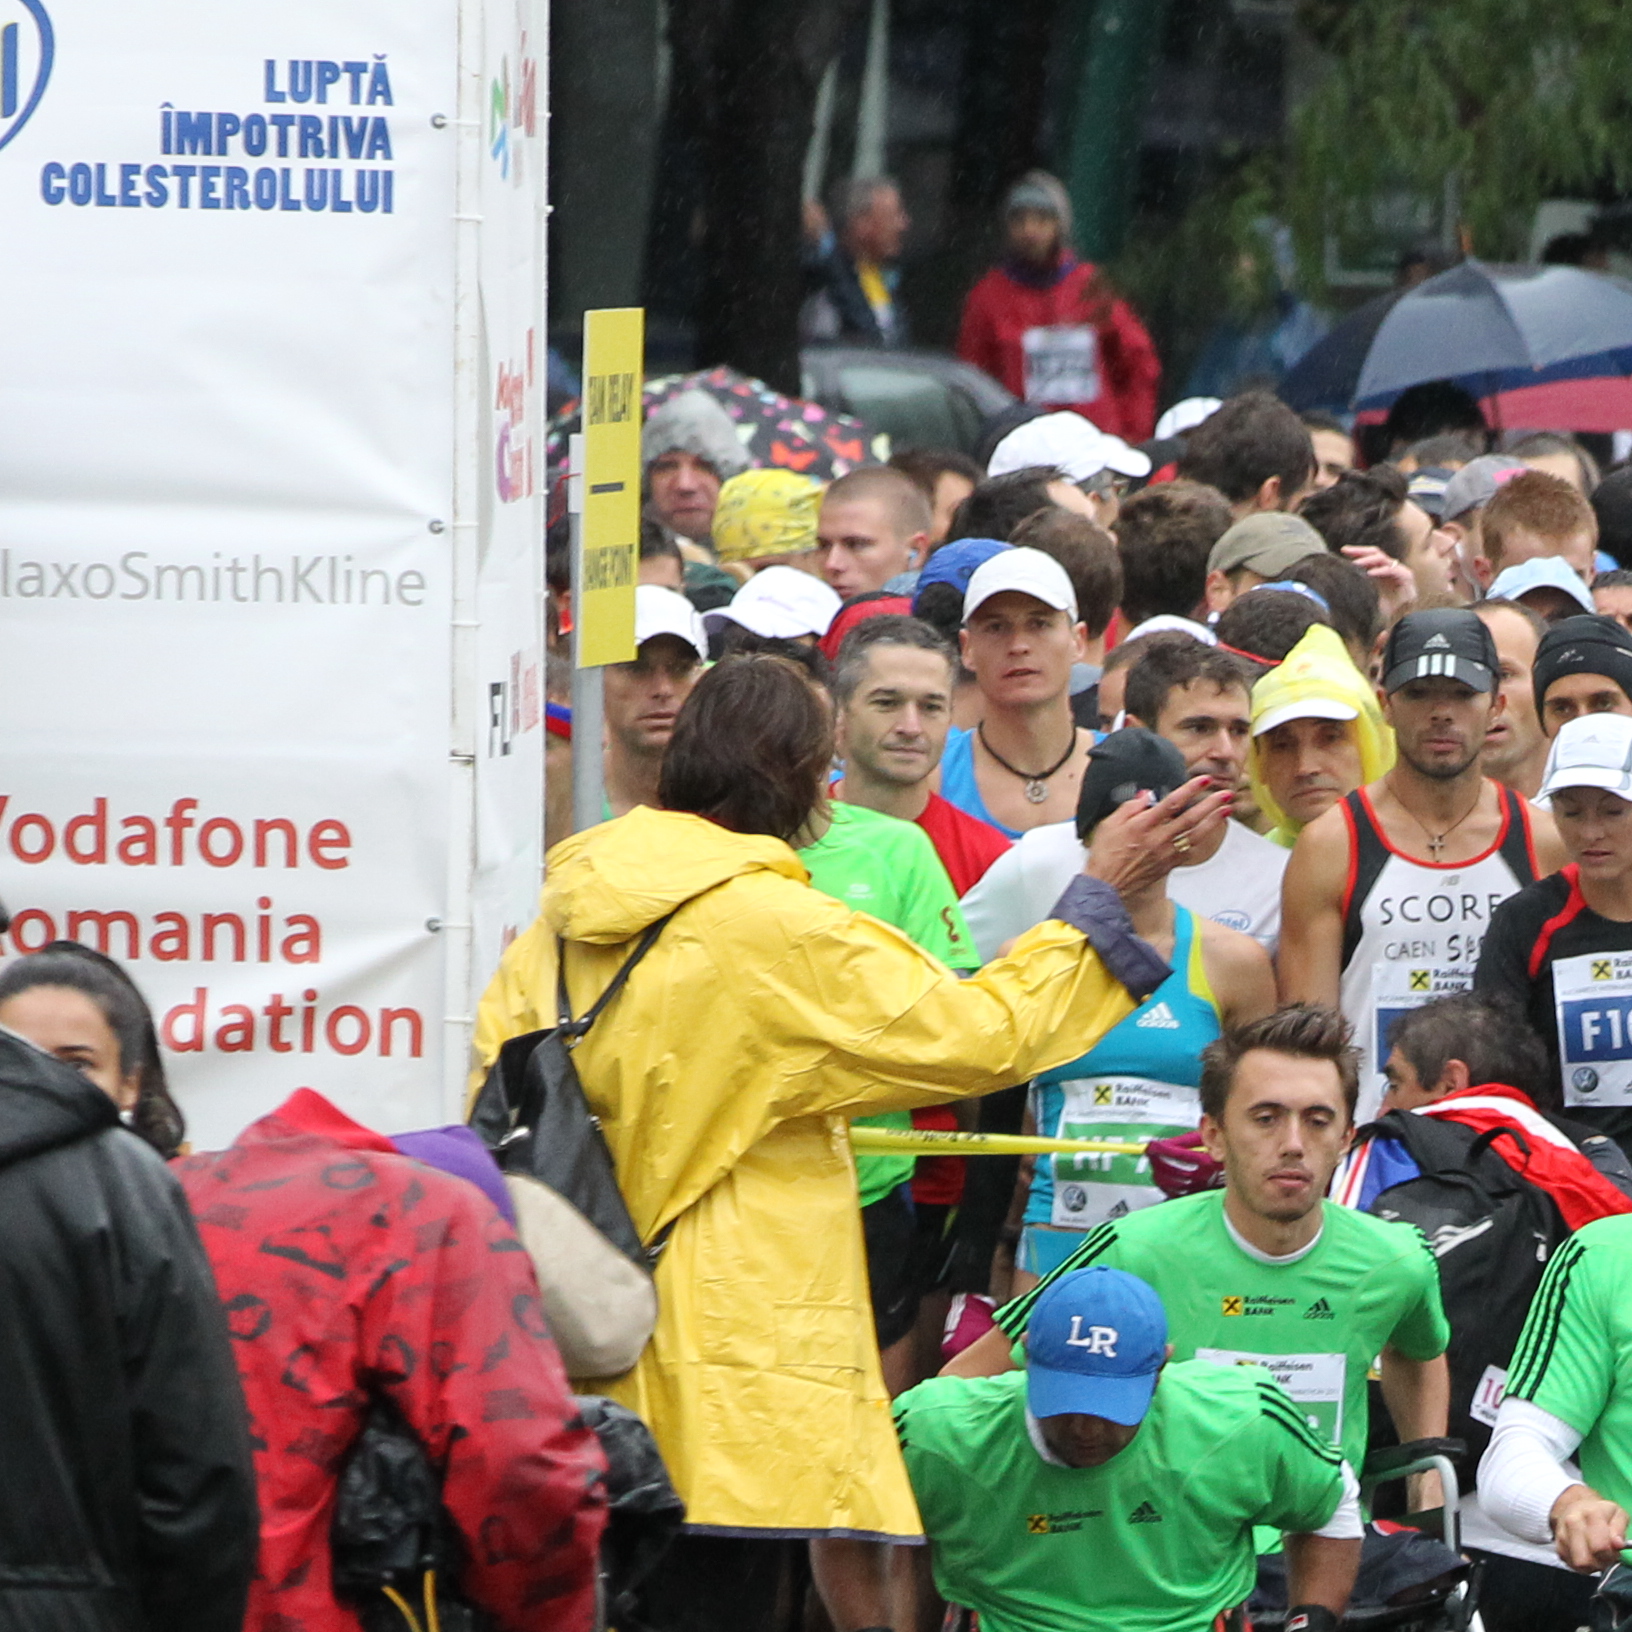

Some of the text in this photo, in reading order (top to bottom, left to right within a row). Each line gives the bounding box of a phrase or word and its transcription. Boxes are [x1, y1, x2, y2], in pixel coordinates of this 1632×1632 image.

[264, 54, 393, 106] LUPTĂ
[159, 102, 394, 160] ÎMPOTRIVA
[41, 162, 394, 214] COLESTEROLULUI
[0, 896, 323, 964] omania
[1385, 941, 1436, 961] CAEN
[161, 986, 424, 1058] dation
[1066, 1315, 1118, 1358] LR
